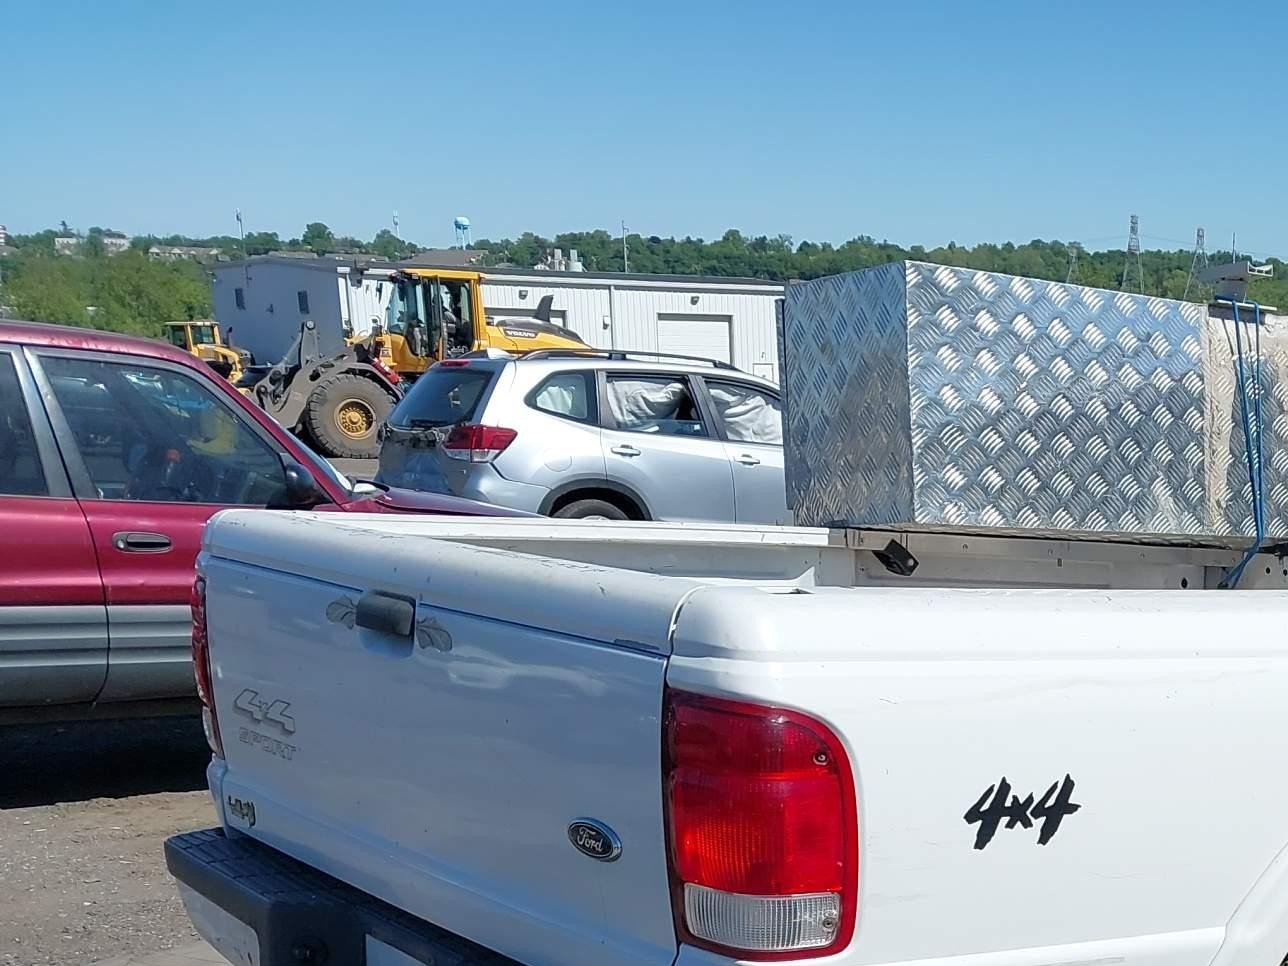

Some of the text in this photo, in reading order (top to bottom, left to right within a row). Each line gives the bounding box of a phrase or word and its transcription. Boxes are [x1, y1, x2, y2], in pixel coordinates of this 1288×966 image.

[506, 330, 536, 338] VOLVO
[239, 726, 297, 760] SPORT
[963, 773, 1082, 850] 4x4
[577, 827, 604, 852] Ford
